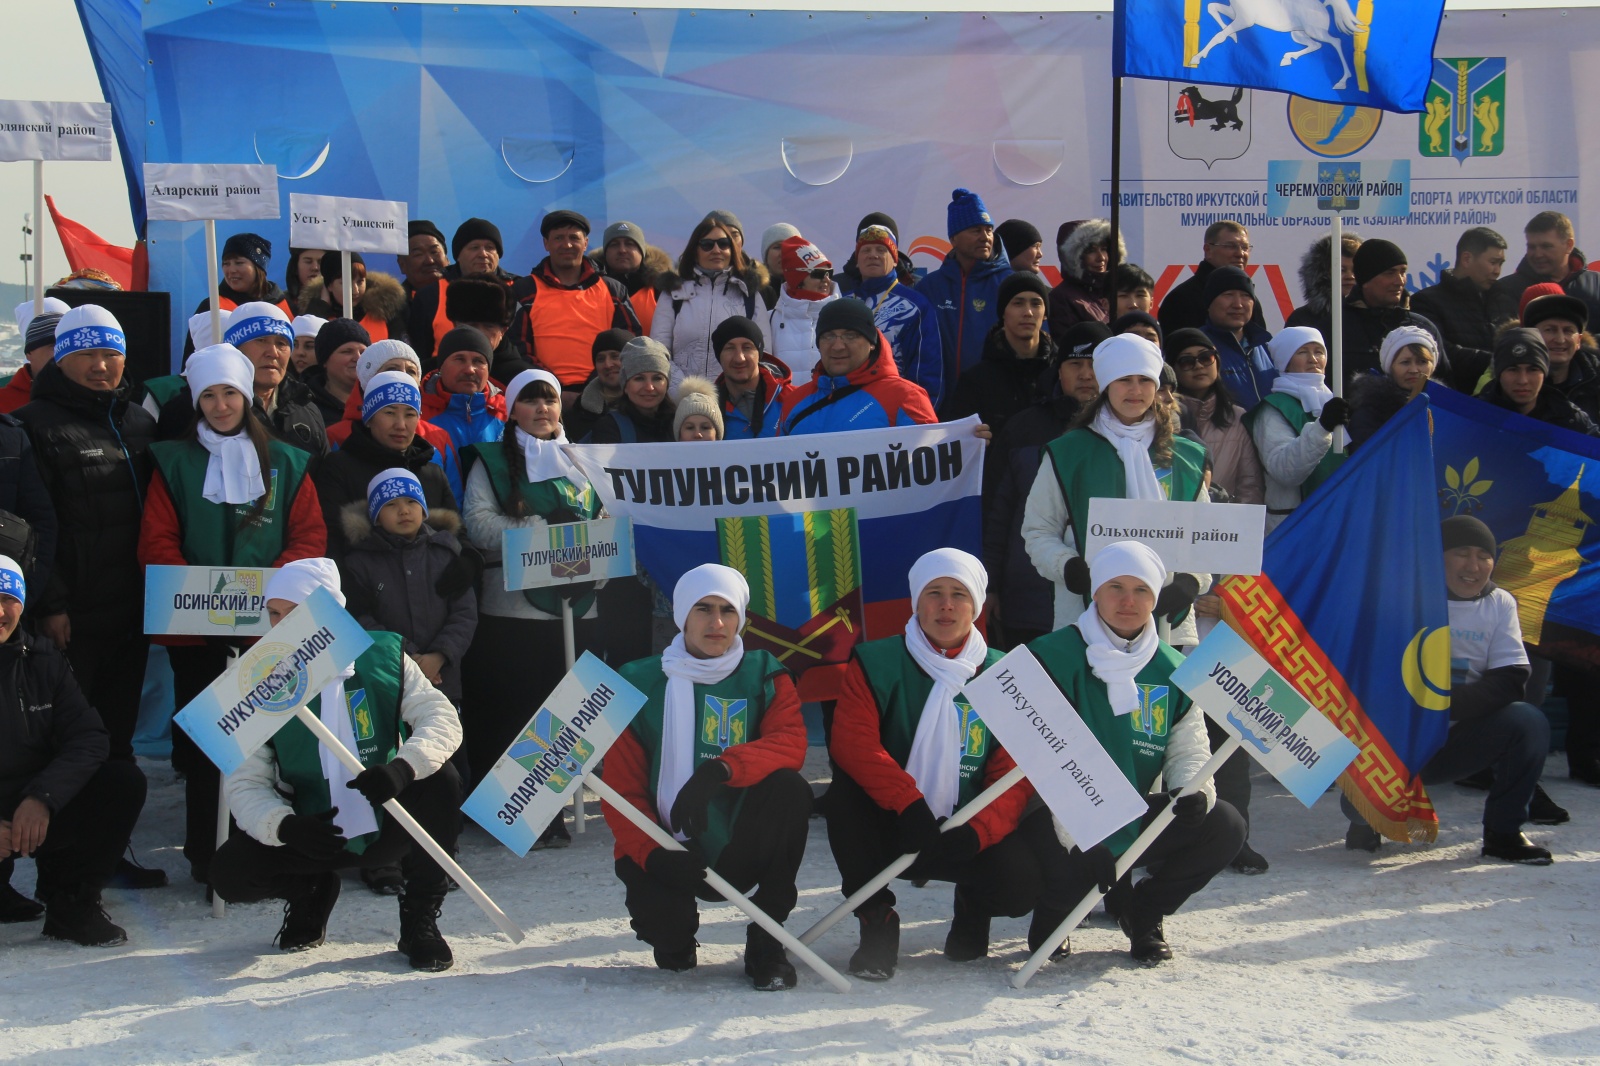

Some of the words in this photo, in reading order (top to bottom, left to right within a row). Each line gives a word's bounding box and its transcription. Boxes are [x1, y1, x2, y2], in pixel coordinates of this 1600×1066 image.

[58, 123, 96, 138] район
[151, 184, 219, 199] Аларский
[226, 185, 261, 198] район
[1195, 190, 1260, 207] ИРКУТСКОЙ
[1410, 191, 1452, 205] СПОРТА
[1458, 188, 1523, 205] ИРКУТСКОЙ
[1527, 189, 1577, 204] ОБЛАСТИ
[1275, 181, 1364, 197] ЧЕРЕМХОВСКИЙ
[1366, 180, 1403, 196] РАЙОН
[342, 216, 395, 229] Удинский
[1453, 208, 1497, 225] РАЙОН»
[603, 450, 828, 507] ТУЛУНСКИЙ
[837, 440, 963, 496] РАЙОН
[1090, 523, 1184, 540] Ольхонский
[1191, 528, 1239, 544] район
[521, 543, 583, 567] ТУЛУНСКИЙ
[585, 541, 618, 560] РАЙОН
[174, 591, 248, 611] ОСИНСКИЙ
[217, 658, 296, 736] НУКУТСКИЙ
[291, 626, 336, 672] РАЙОН
[1208, 661, 1286, 735] УСОЛЬСКИЙ
[1274, 725, 1321, 770] РАЙОН
[995, 668, 1068, 755] Иркутский
[1060, 758, 1105, 808] район
[497, 724, 581, 826] ЗАЛАРИНСКИЙ
[570, 683, 616, 733] РАЙОН
